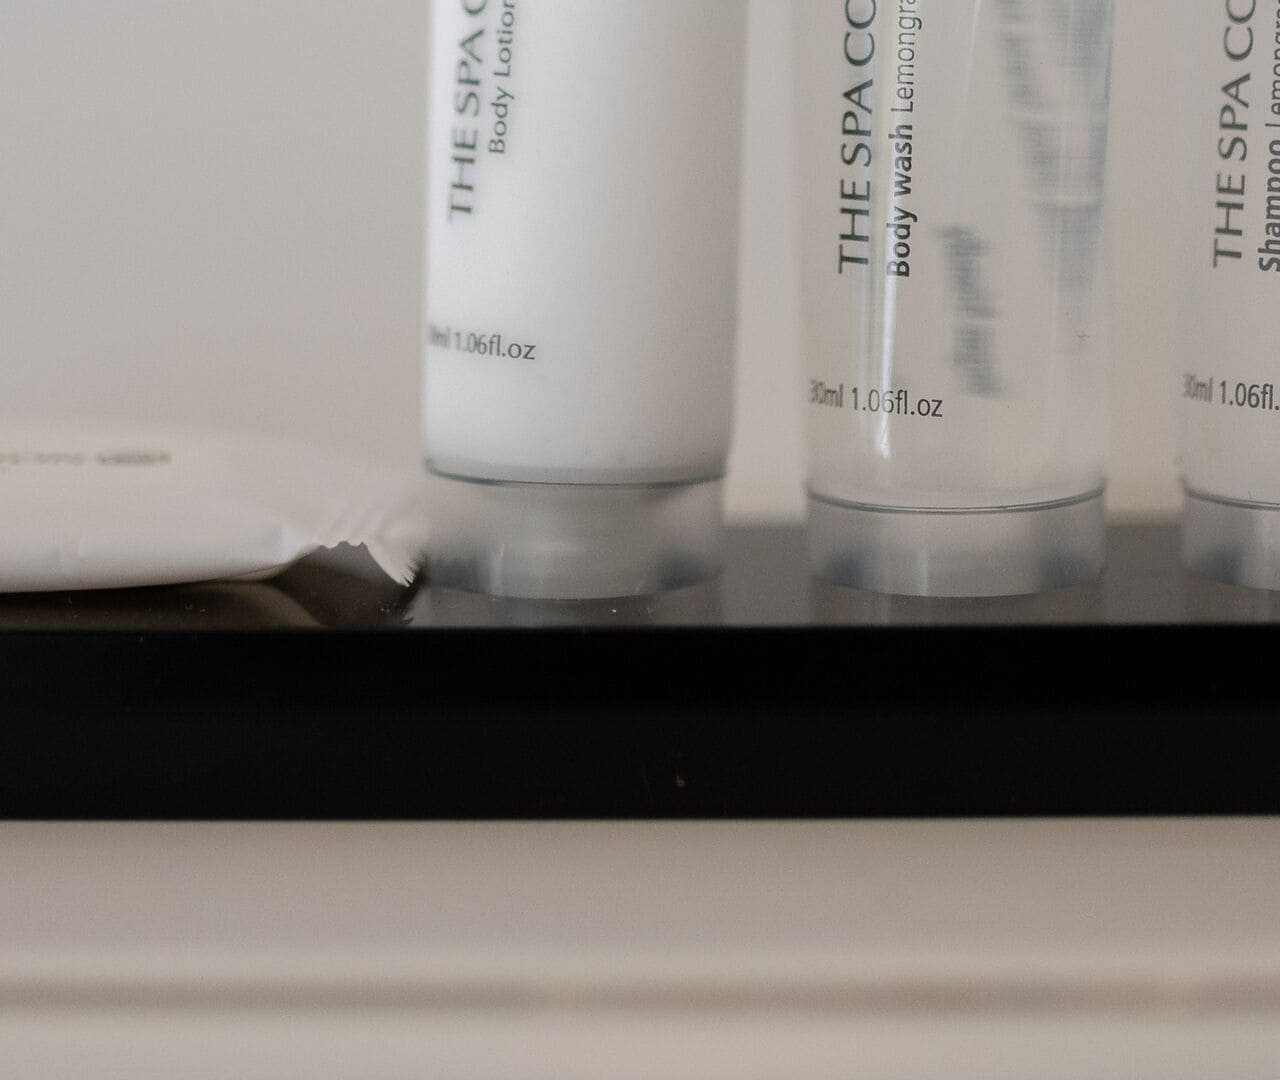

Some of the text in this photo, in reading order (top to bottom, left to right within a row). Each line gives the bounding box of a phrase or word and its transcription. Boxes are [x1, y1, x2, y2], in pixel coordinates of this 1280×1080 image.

[452, 27, 485, 117] SPA
[1218, 72, 1251, 162] SPA
[488, 87, 515, 154] Body
[840, 78, 873, 168] SPA
[888, 124, 913, 197] wash
[447, 127, 477, 224] THE
[838, 179, 870, 274] THE
[886, 206, 918, 277] Body
[1213, 173, 1246, 269] THE
[453, 329, 536, 360] 1.06fl.oz
[852, 387, 943, 417] 1.06fl.oz
